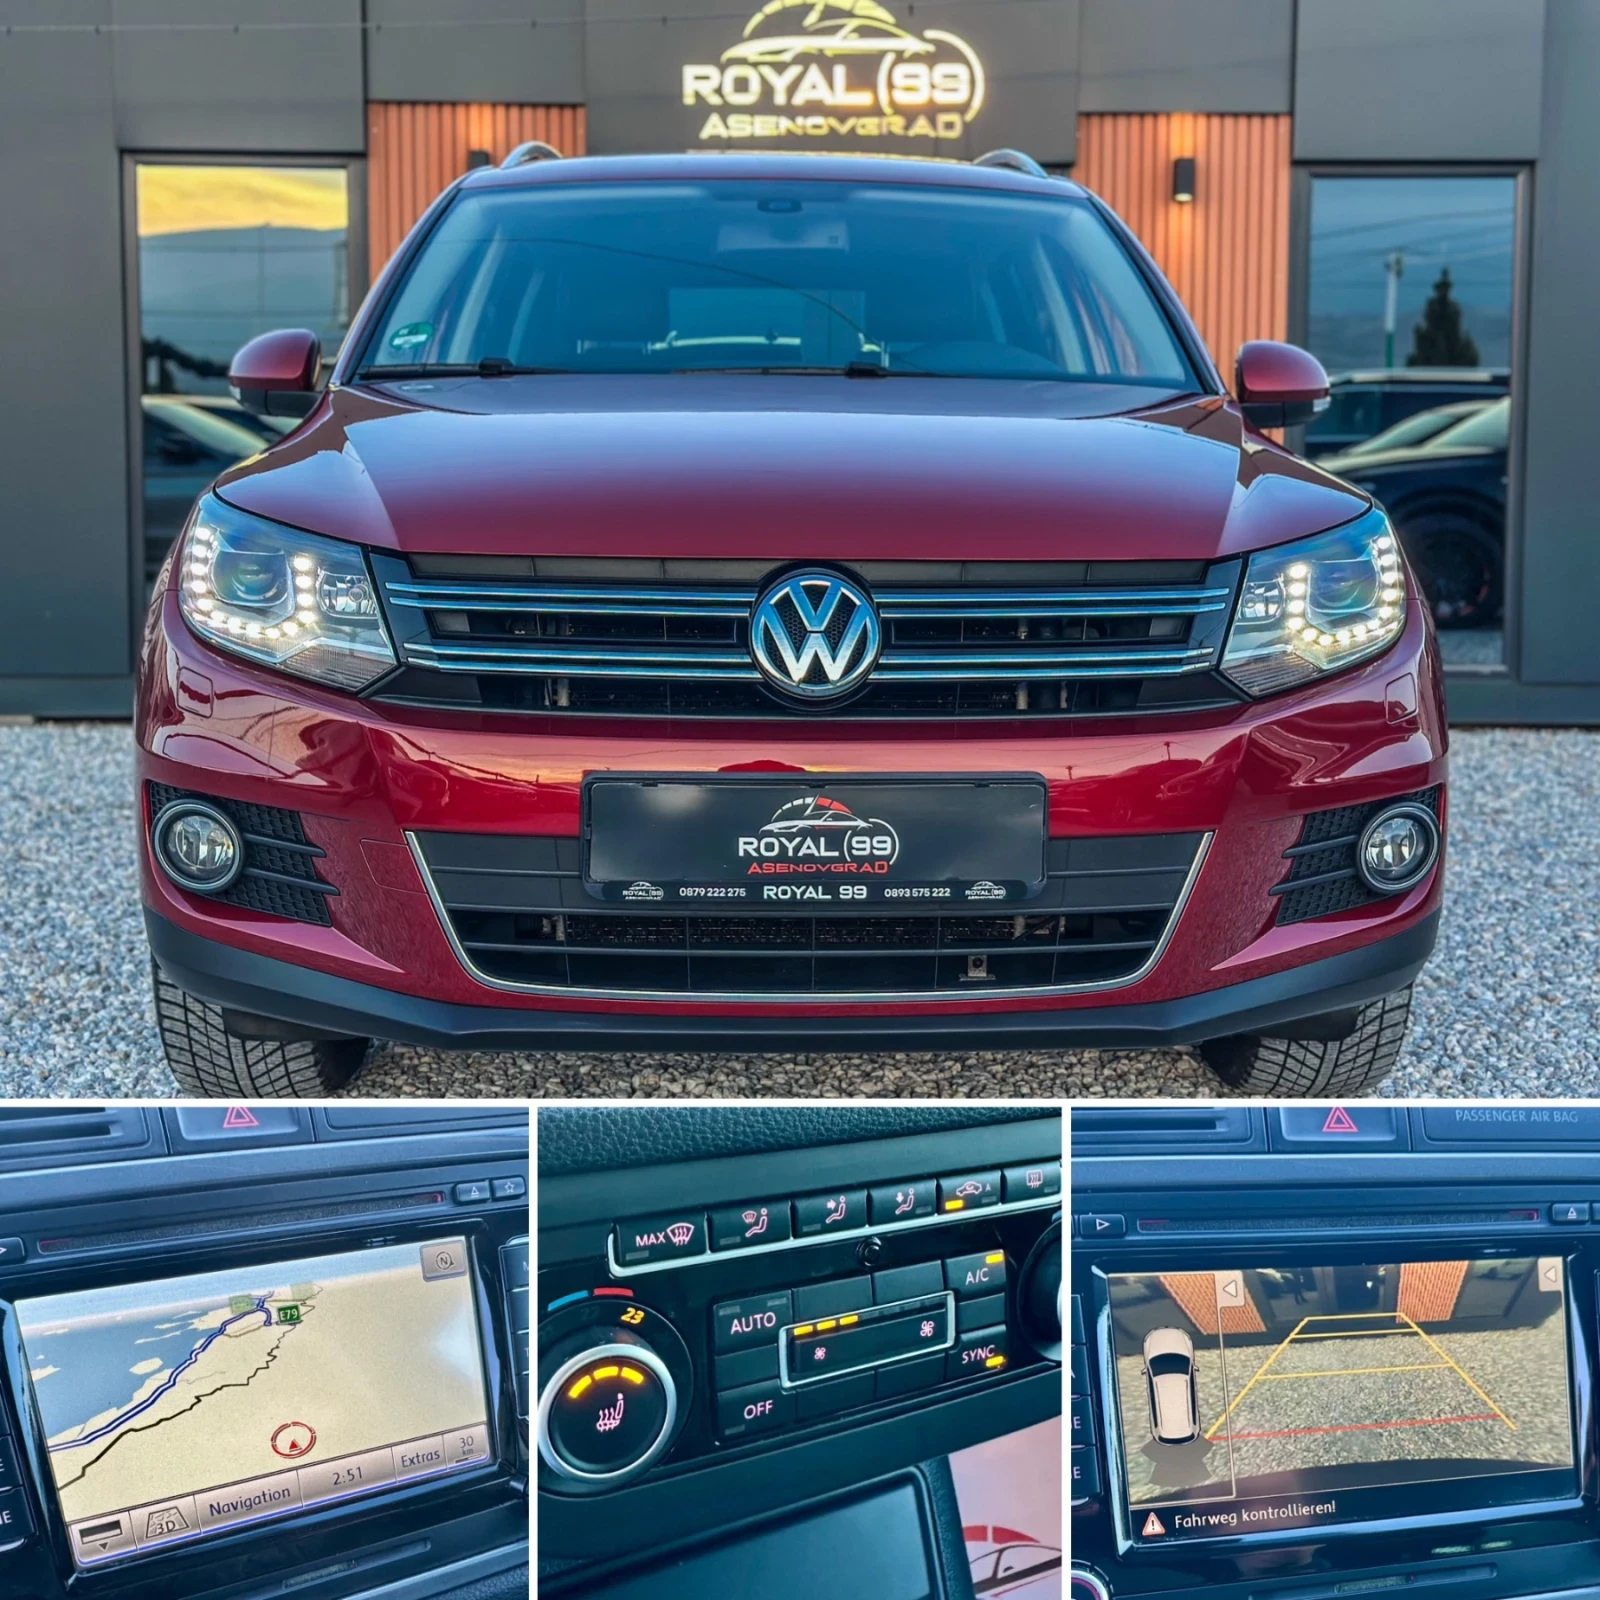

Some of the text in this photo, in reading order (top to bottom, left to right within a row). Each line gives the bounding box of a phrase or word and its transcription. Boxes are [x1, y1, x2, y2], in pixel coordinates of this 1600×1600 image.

[682, 63, 874, 106] ROYAL
[699, 112, 964, 139] ASENOVGRAD
[738, 836, 840, 857] ROYAL
[747, 861, 888, 874] ASENOVGRAD
[679, 887, 746, 897] 0879 222 275
[763, 885, 867, 899] ROYAL 99
[884, 887, 951, 898] 0893 575 222
[1455, 1109, 1579, 1123] PASSENGER AIR BAG
[635, 1232, 666, 1247] MAX
[965, 1268, 989, 1285] A/C
[280, 1309, 298, 1321] E79
[621, 1307, 645, 1324] 23
[730, 1312, 776, 1334] AUTO
[962, 1344, 995, 1364] SYNC
[744, 1400, 773, 1419] OFF
[459, 1435, 474, 1449] 30
[401, 1449, 441, 1468] Extras
[461, 1446, 475, 1456] km
[333, 1467, 364, 1485] 2:51
[208, 1486, 291, 1517] Navigation
[1174, 1500, 1336, 1528] Fahrweg kontrollieren!
[156, 1519, 177, 1534] 3D
